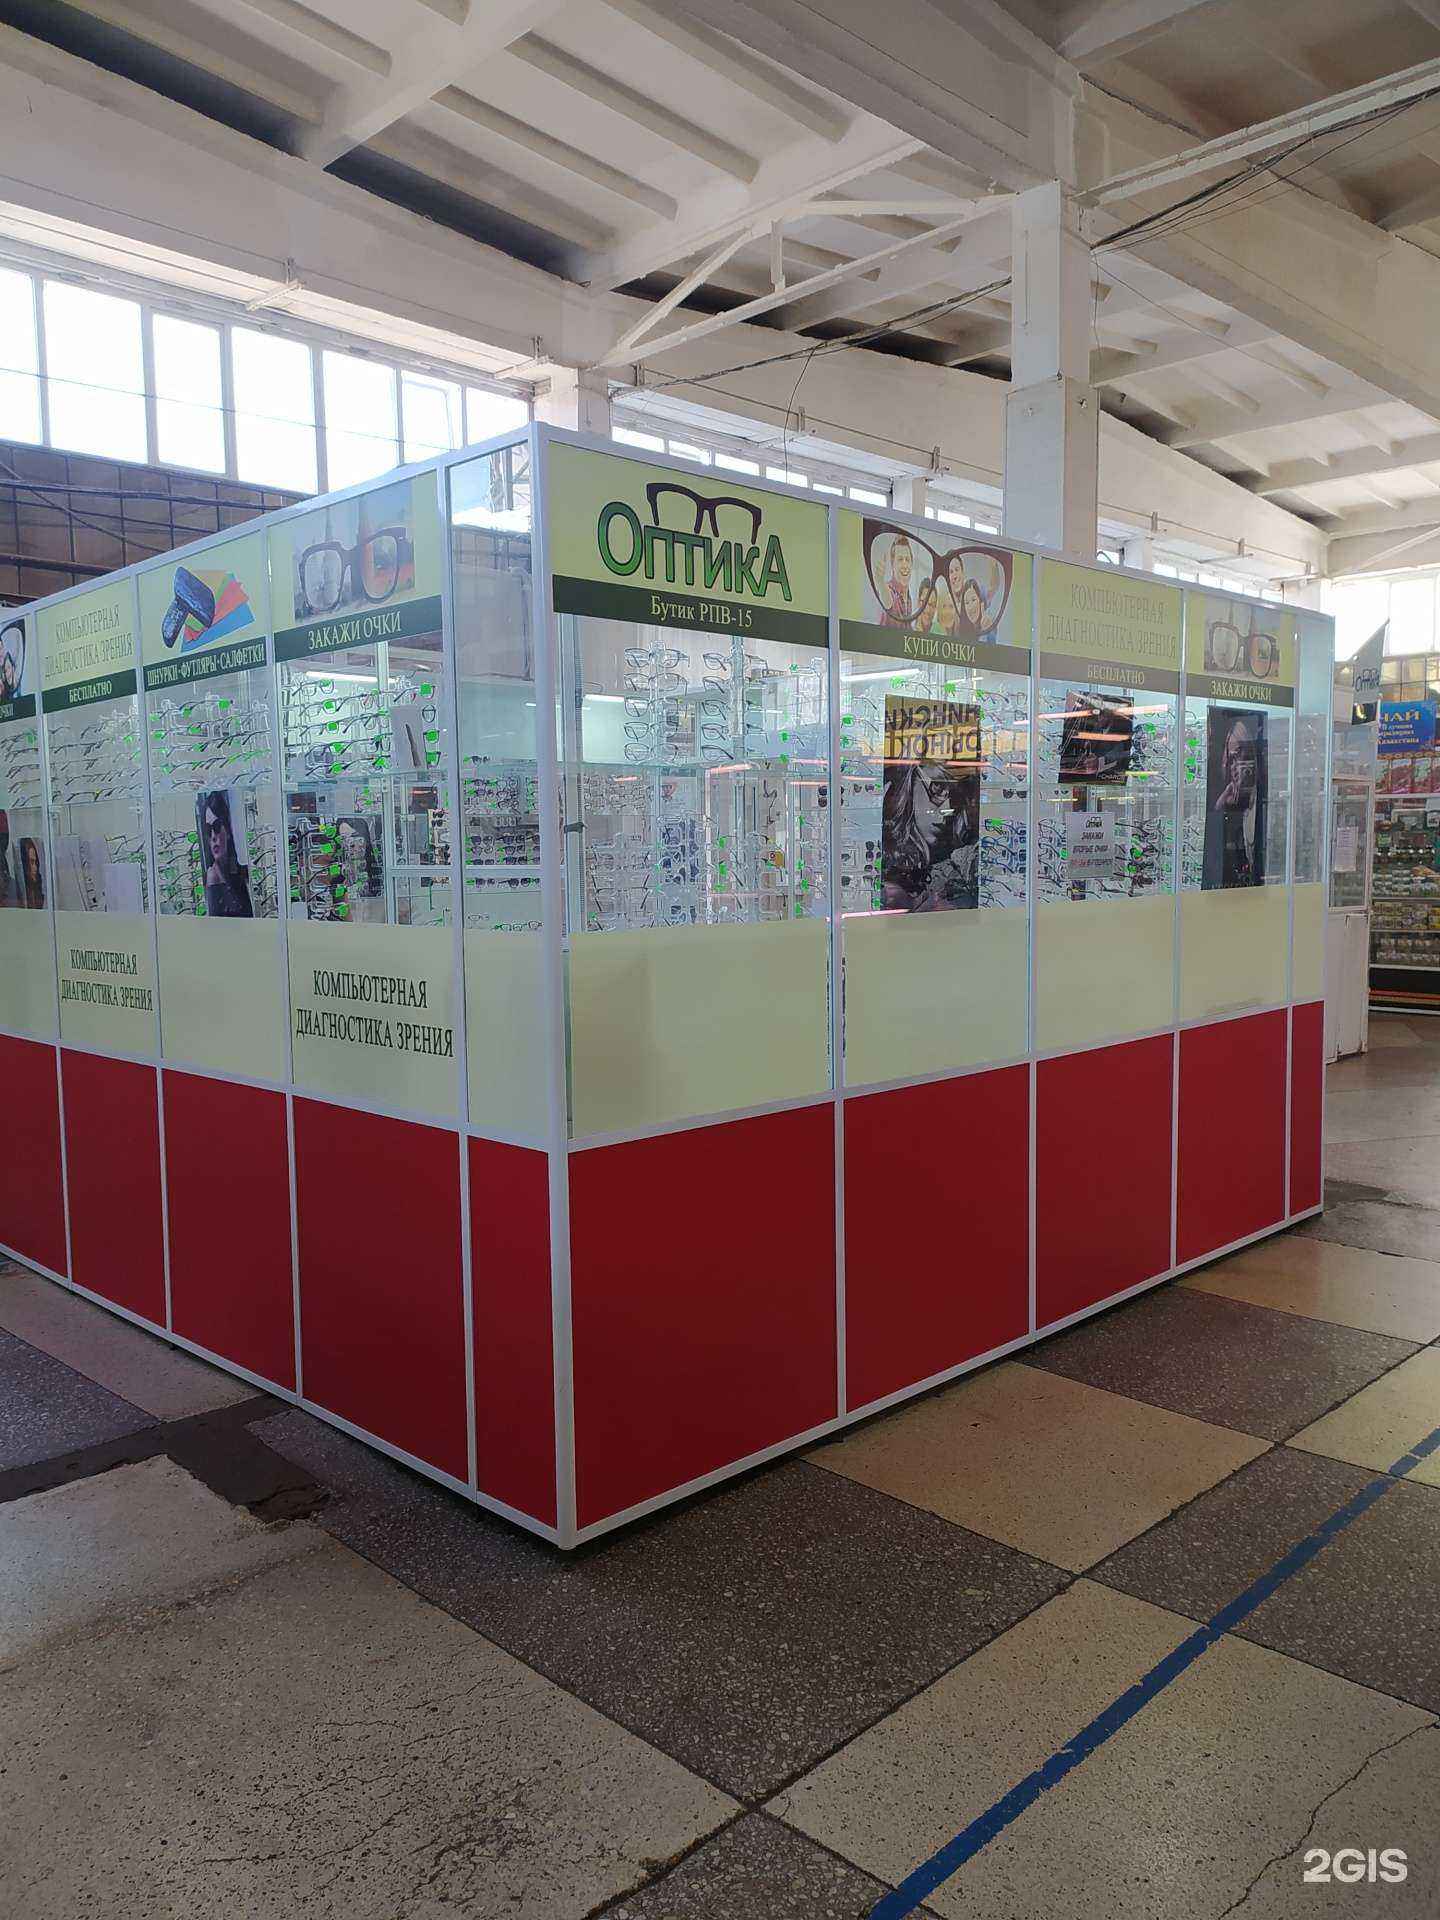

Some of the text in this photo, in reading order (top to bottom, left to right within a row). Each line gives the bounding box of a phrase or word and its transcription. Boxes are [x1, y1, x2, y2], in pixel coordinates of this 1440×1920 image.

[650, 595, 753, 628] Бутик РПВ-15
[1071, 583, 1165, 625] КОМПЬЮТЕРНАЯ
[55, 604, 120, 645] КОМПЬЮТЕРНАЯ
[308, 611, 402, 650] ЗАКАЖИ ОЧКИ
[1047, 614, 1177, 660] ДИАГНОСТИКА ЗРЕНИЯ
[45, 632, 134, 678] ДИАГНОСТИКА ЗРЕНИЯ
[903, 635, 976, 663] КУПИ ОЧКИ
[69, 680, 113, 703] БЕСПЛАТНО
[1087, 664, 1145, 686] БЕСПЛАТНО
[1210, 680, 1272, 702] ЗАКАЖИ ОЧКИ
[70, 949, 138, 975] КОМПЬЮТЕРНАЯ
[61, 979, 154, 1011] ДИАГНОСТИКА ЗРЕНИЯ
[313, 970, 428, 1009] КОМПЬЮТЕРНАЯ
[296, 1008, 454, 1058] ДИАГНОСТИКА ЗРЕНИЯ
